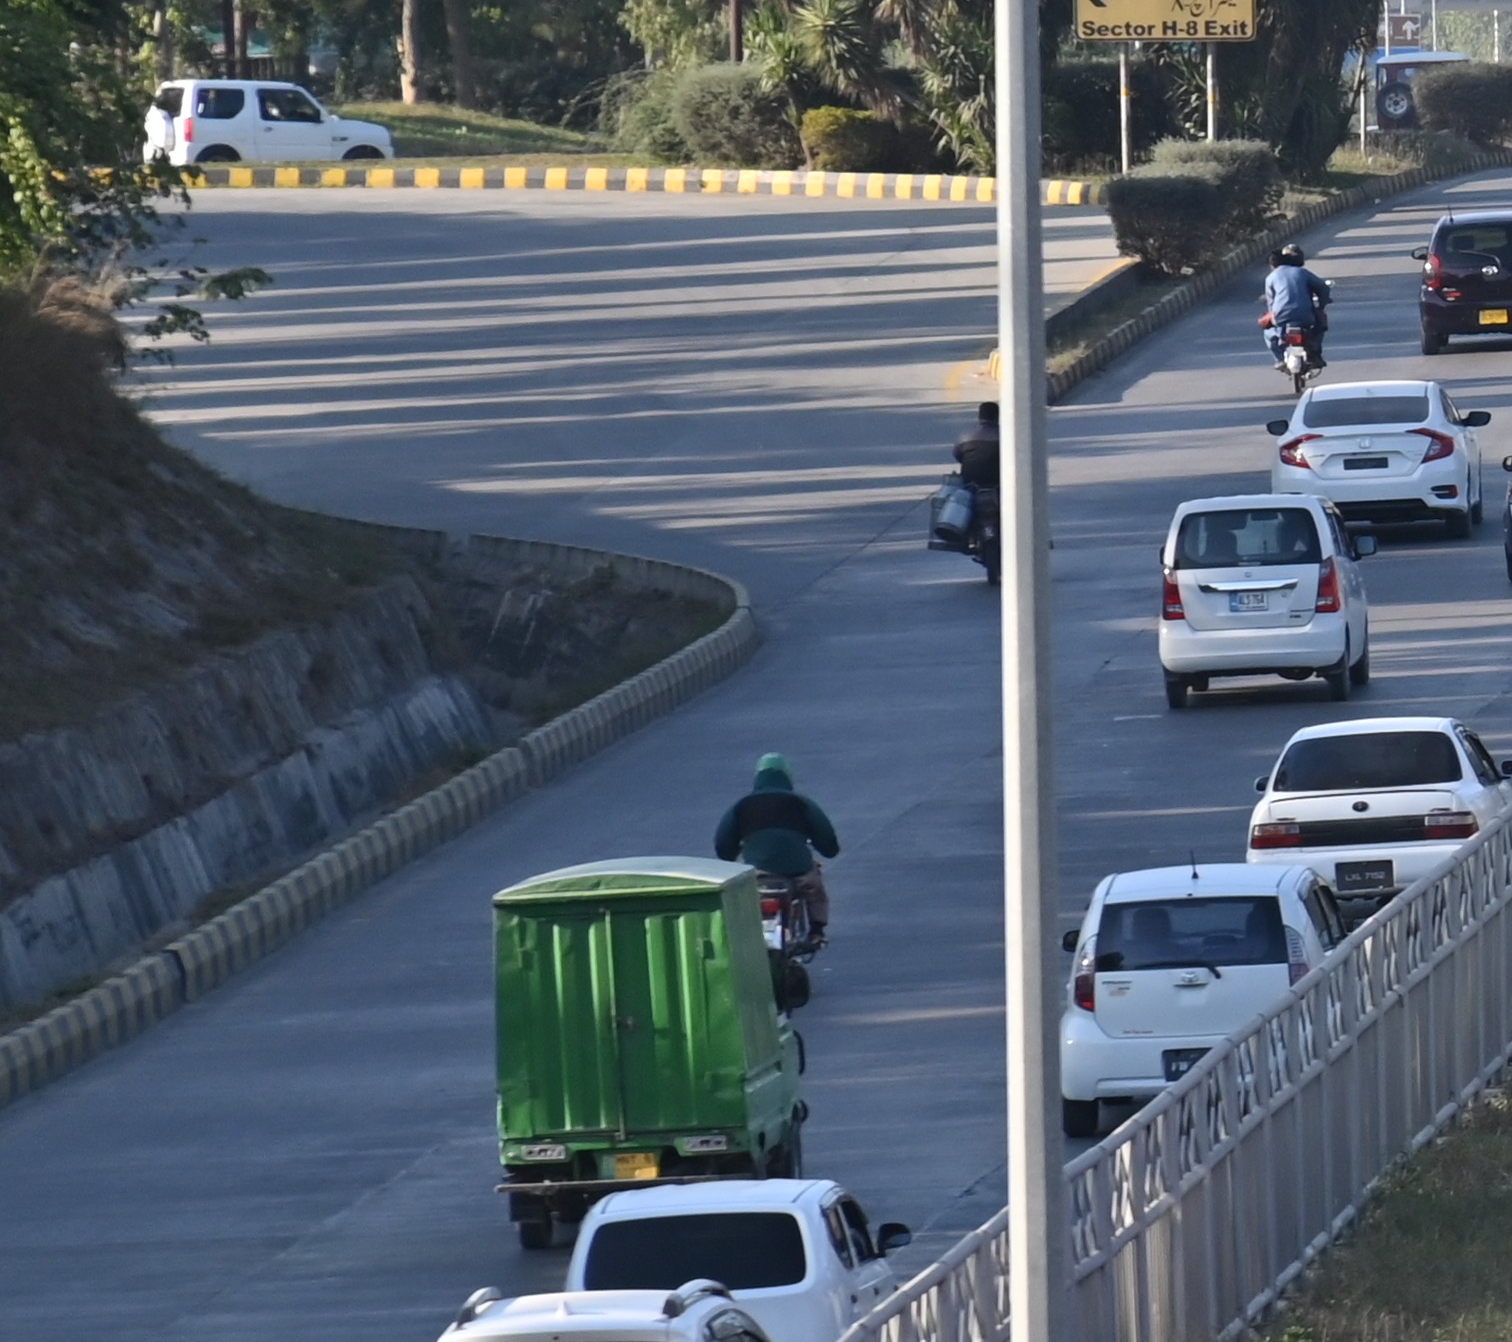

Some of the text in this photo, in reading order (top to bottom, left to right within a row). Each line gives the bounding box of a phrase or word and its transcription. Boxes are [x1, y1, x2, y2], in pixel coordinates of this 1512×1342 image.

[1081, 19, 1248, 37] Sector H-8 Exit
